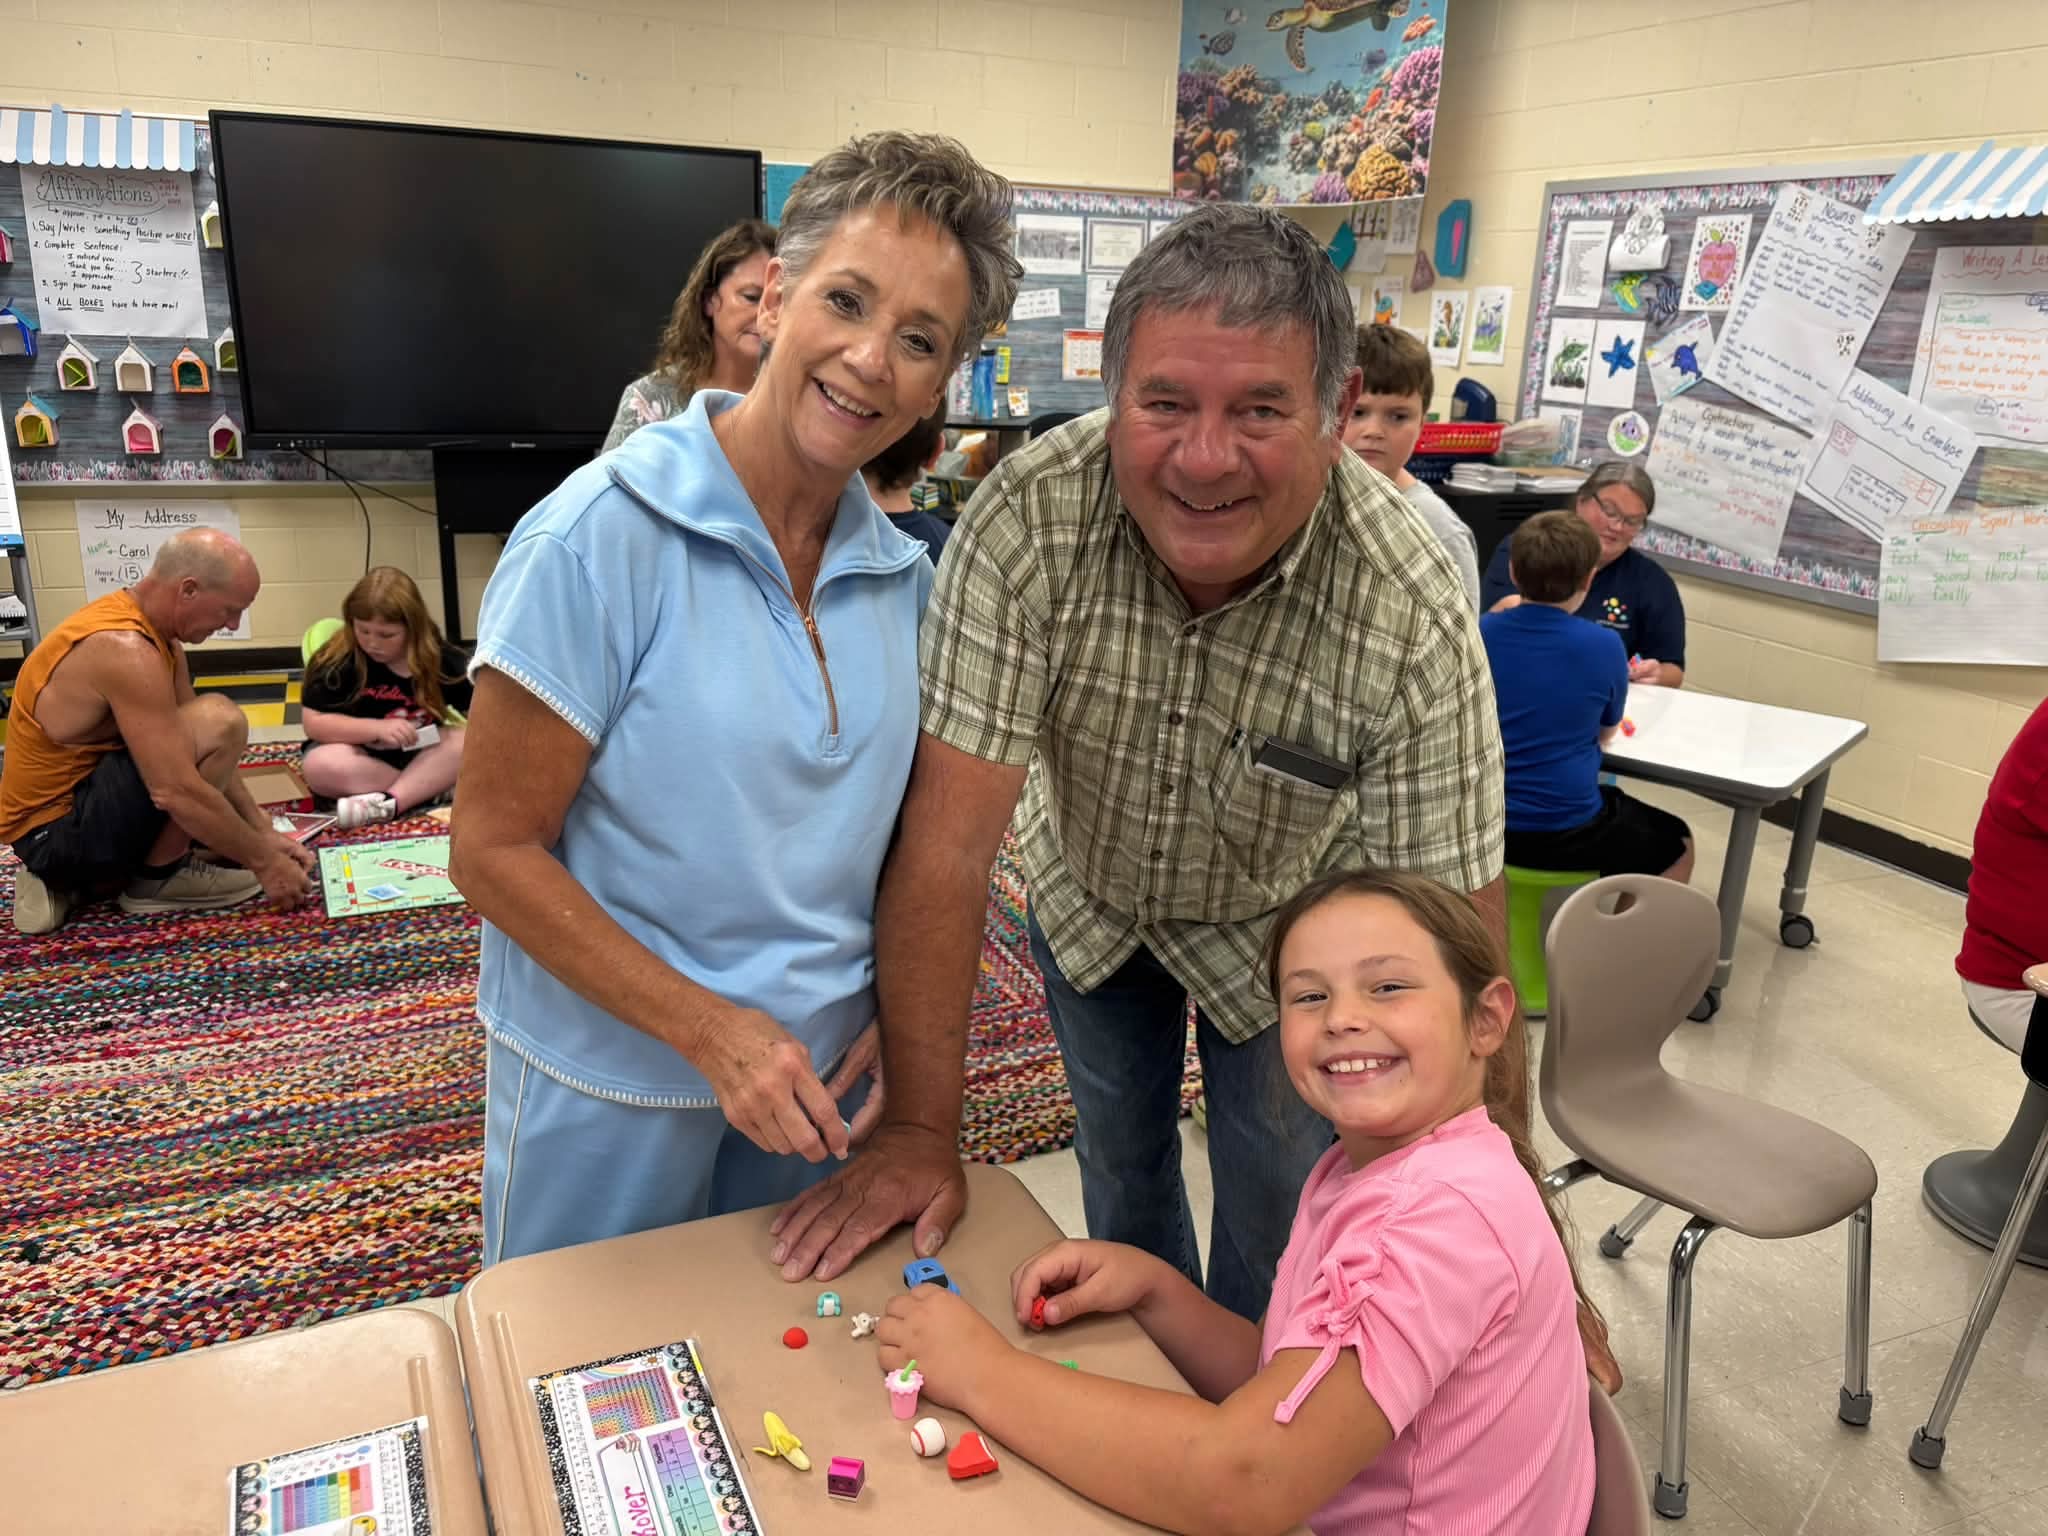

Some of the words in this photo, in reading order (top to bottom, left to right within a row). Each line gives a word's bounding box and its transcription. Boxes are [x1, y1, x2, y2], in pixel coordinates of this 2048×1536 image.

[44, 174, 153, 202] Affirmations
[1822, 202, 1856, 225] Nouns
[44, 240, 75, 250] Complete
[1962, 248, 2005, 280] Writing
[2013, 248, 2024, 265] A
[57, 298, 72, 306] ALL
[1850, 384, 1894, 425] Addressing
[1921, 426, 1963, 457] Envelope
[106, 509, 125, 530] My
[144, 508, 198, 524] Address
[120, 544, 150, 557] Carol
[1998, 545, 2028, 561] next
